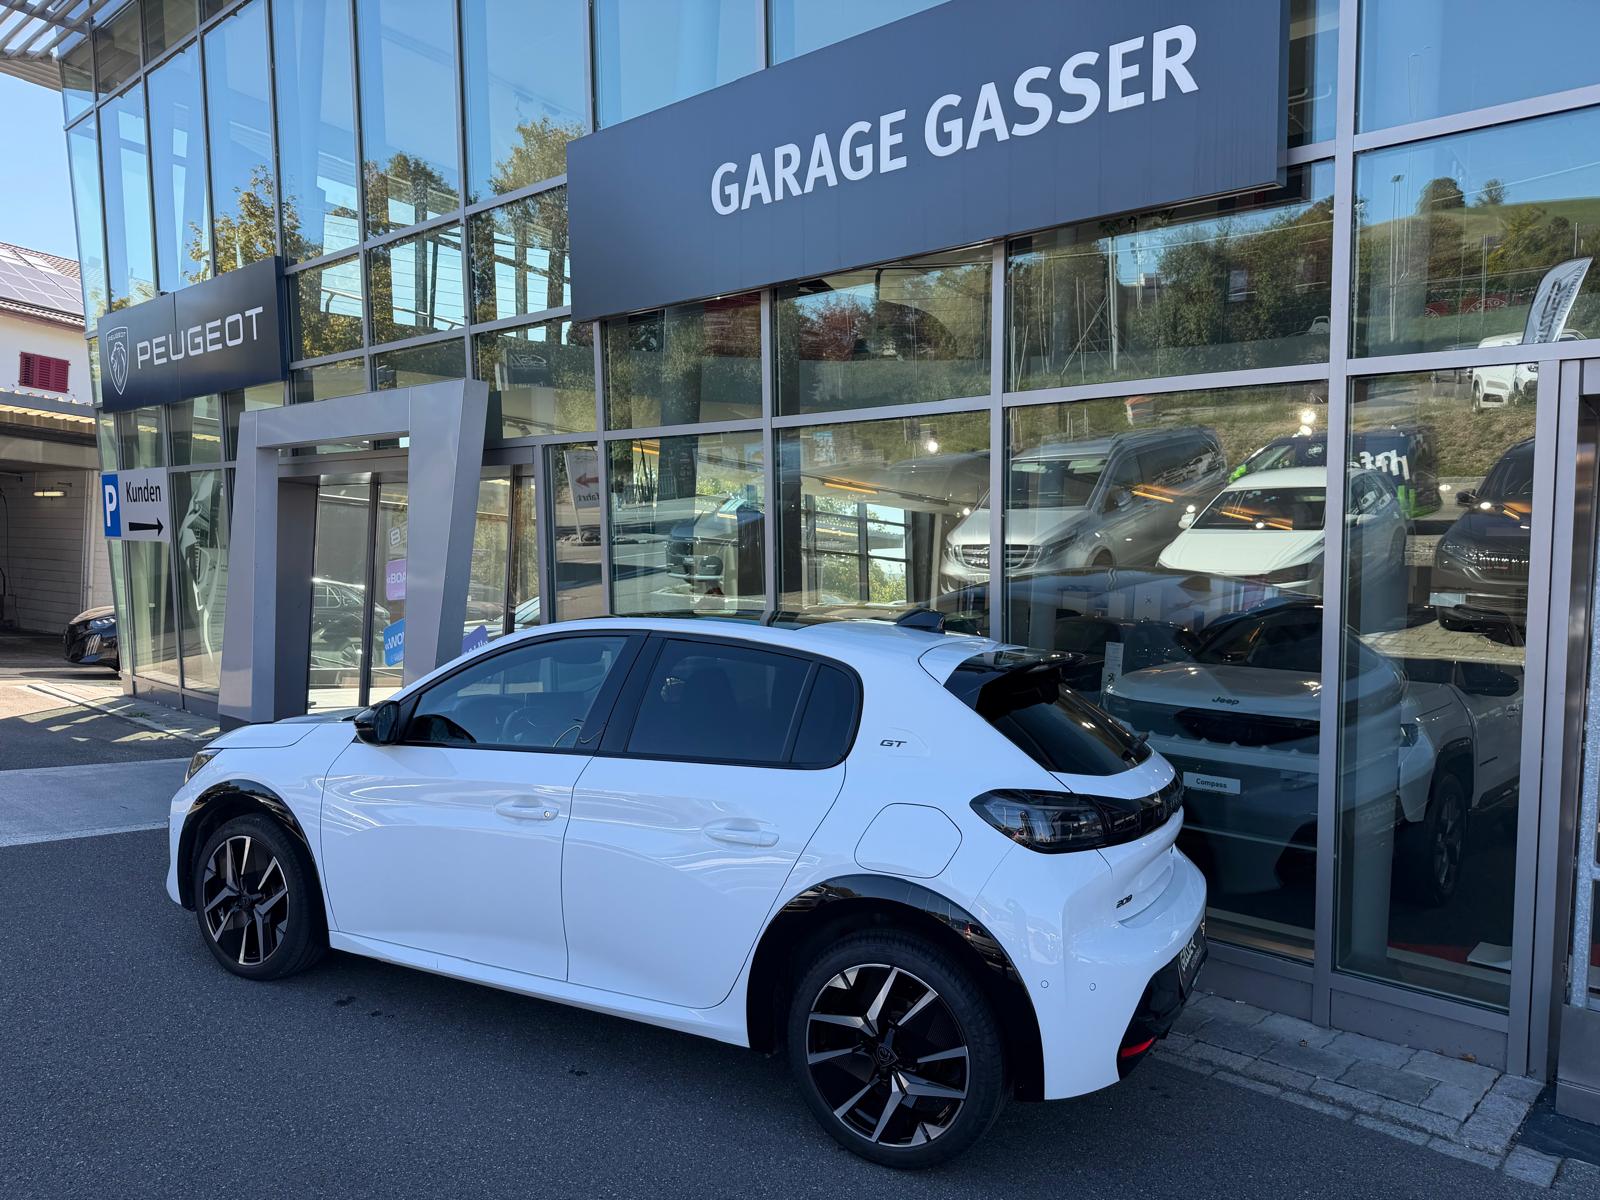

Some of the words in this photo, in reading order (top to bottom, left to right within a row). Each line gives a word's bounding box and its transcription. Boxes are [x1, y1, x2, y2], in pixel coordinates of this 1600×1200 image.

[711, 109, 908, 216] GARAGE
[924, 24, 1200, 158] GASSER
[136, 306, 264, 370] PEUGEOT
[126, 478, 162, 503] Kunden
[104, 484, 117, 528] P
[1212, 696, 1240, 706] Jeep
[880, 739, 908, 748] GT
[1195, 778, 1228, 789] Compass
